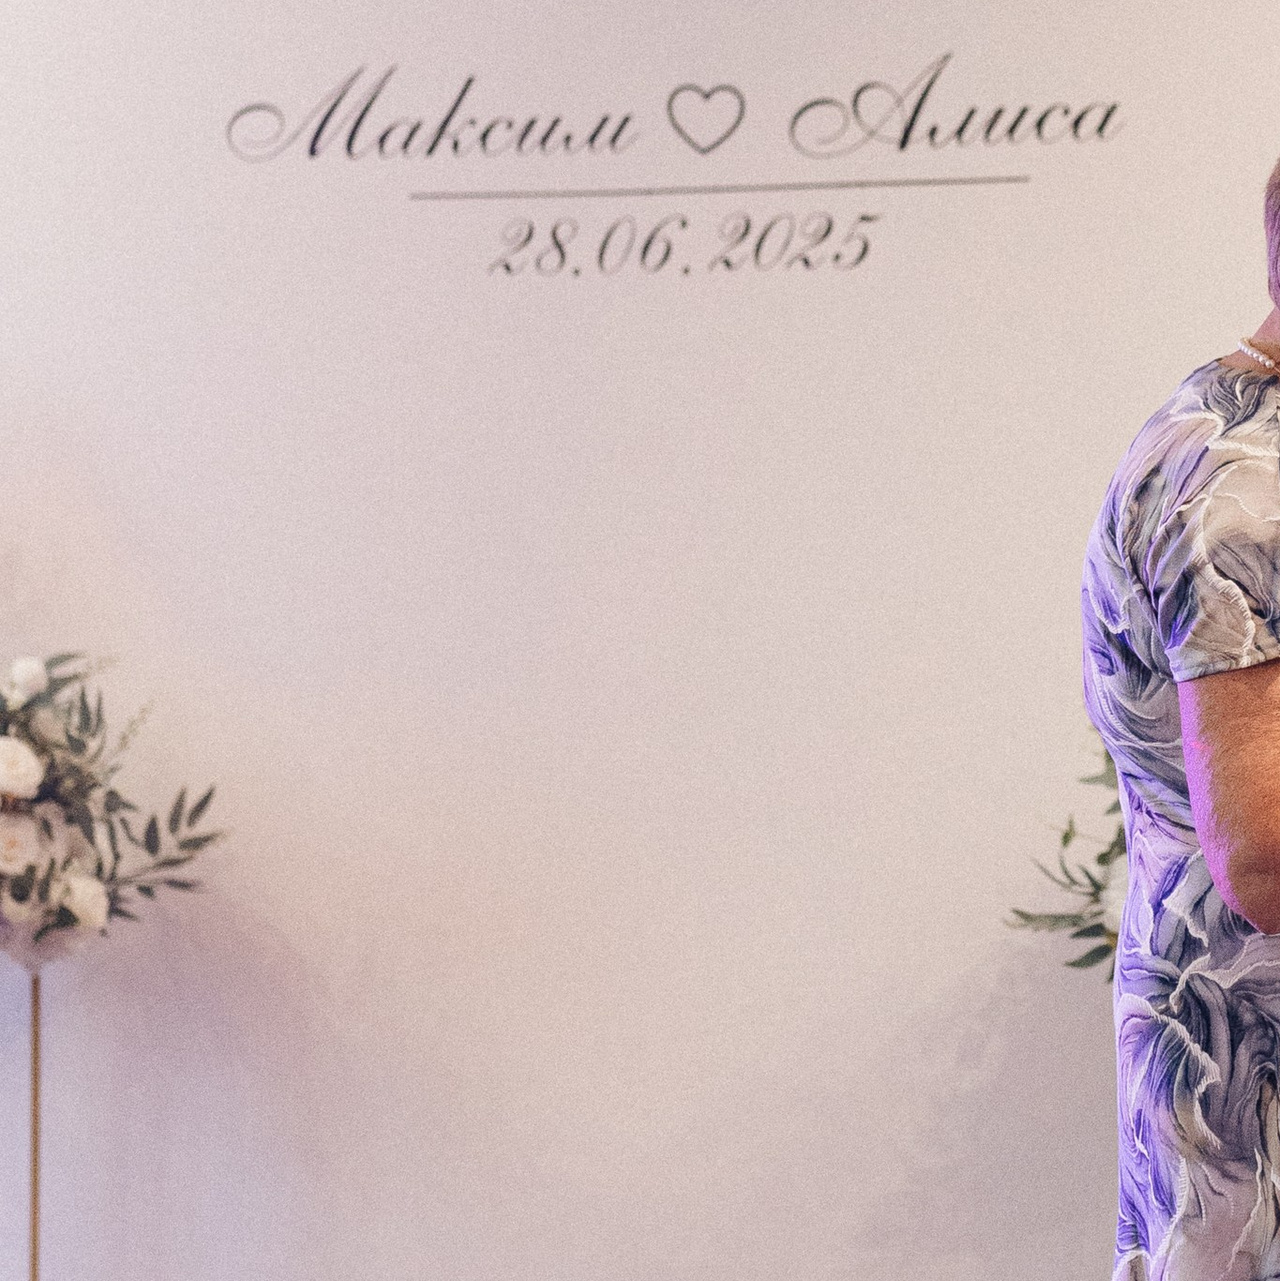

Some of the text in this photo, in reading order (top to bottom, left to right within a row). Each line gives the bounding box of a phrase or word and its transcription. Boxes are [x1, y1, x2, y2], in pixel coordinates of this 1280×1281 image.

[226, 52, 1123, 162] Максим Алиса
[489, 211, 880, 277] 28.06.2025
